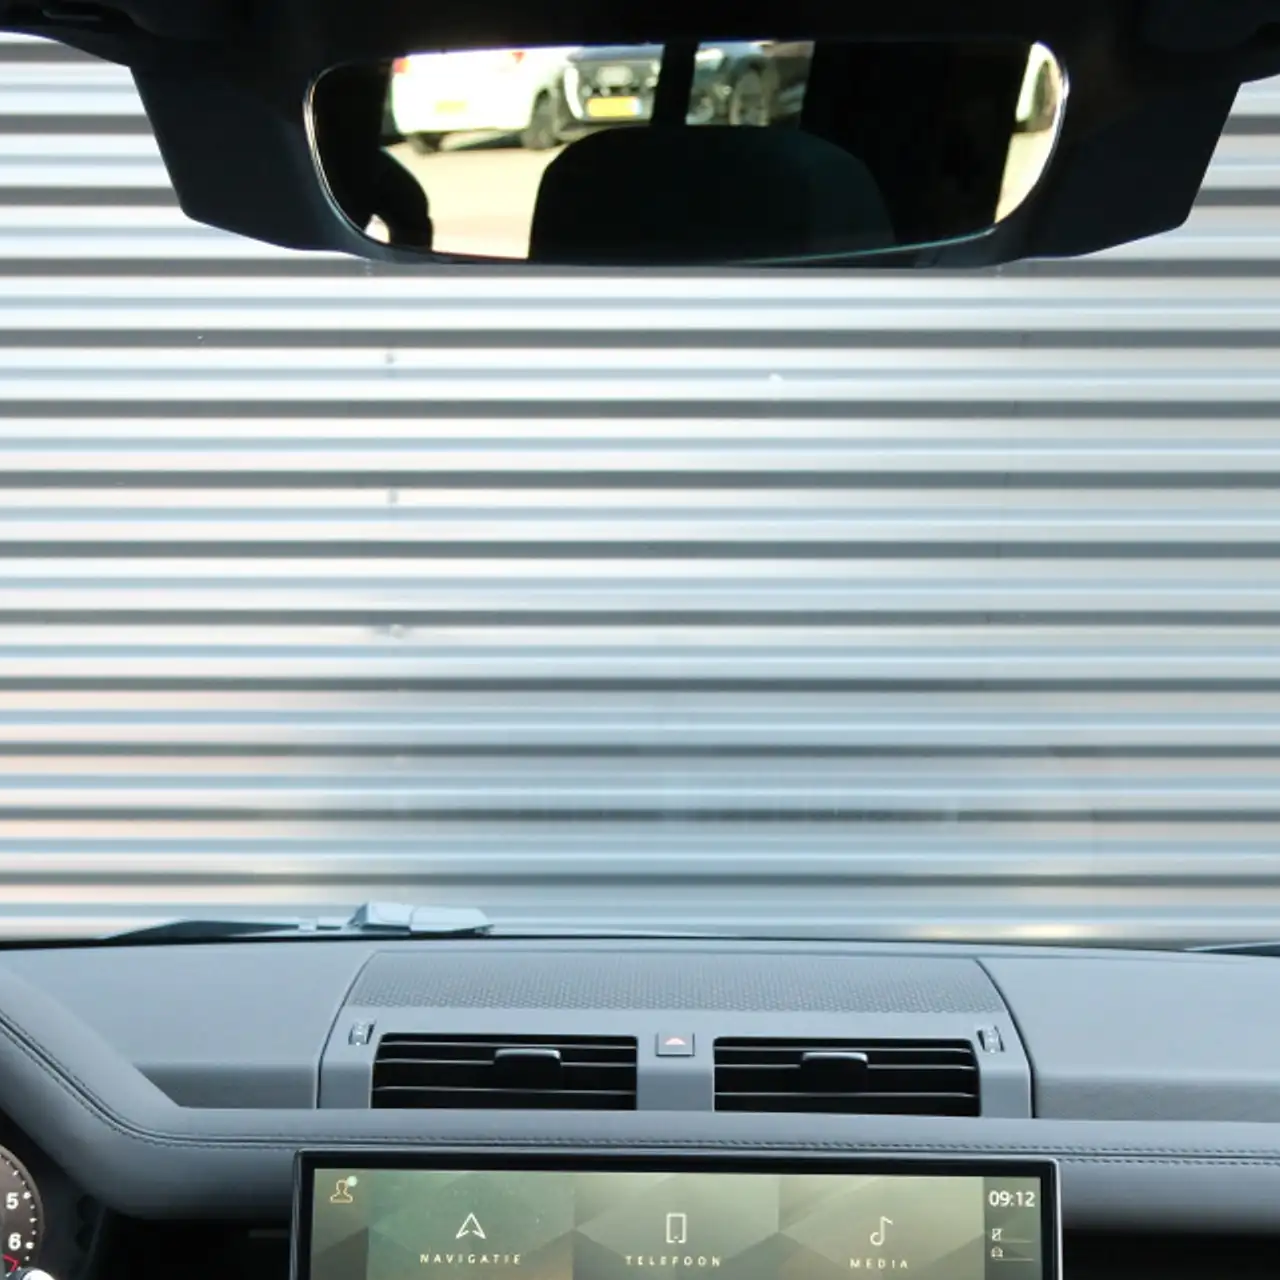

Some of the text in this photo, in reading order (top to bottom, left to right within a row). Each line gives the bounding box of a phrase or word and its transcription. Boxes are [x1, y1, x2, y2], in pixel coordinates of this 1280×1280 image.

[6, 1192, 19, 1209] 5
[988, 1190, 1036, 1207] 09:12
[8, 1232, 21, 1250] 6
[420, 1253, 521, 1265] NAVIGATIE
[624, 1255, 721, 1267] TELEFOON
[849, 1258, 909, 1269] MEDIA
